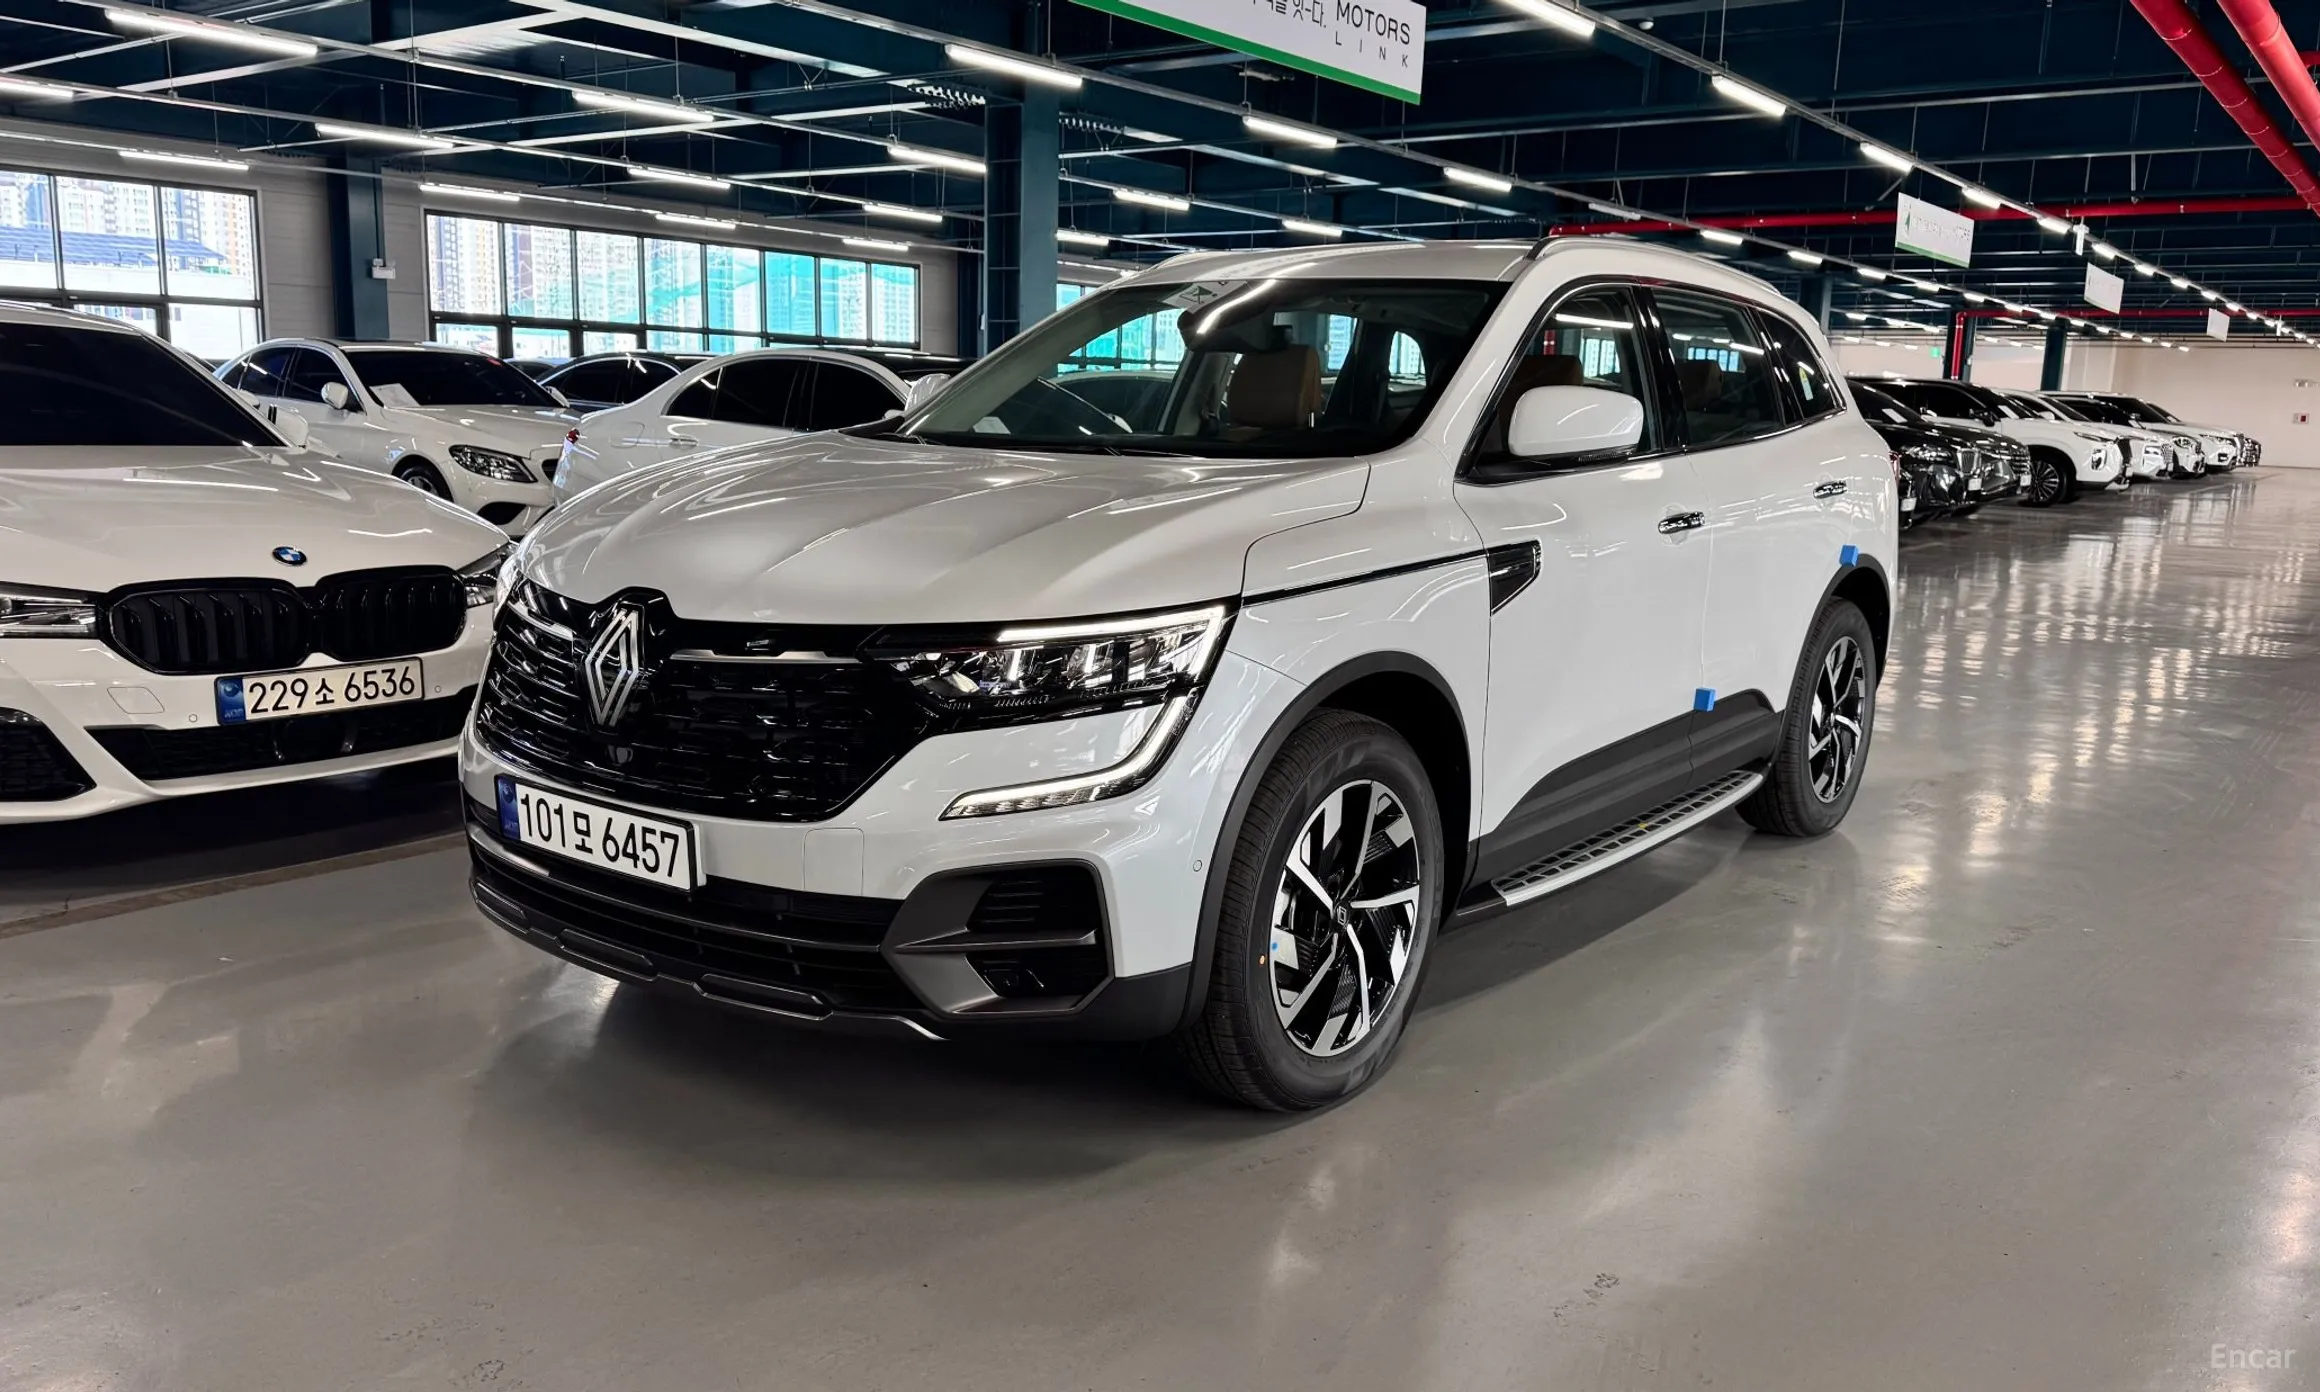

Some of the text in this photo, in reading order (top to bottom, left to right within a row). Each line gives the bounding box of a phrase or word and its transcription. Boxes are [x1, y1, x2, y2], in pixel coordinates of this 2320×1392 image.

[1336, 0, 1410, 45] MOTORS
[249, 666, 415, 714] 229소 6536
[520, 793, 680, 878] 101모 6457
